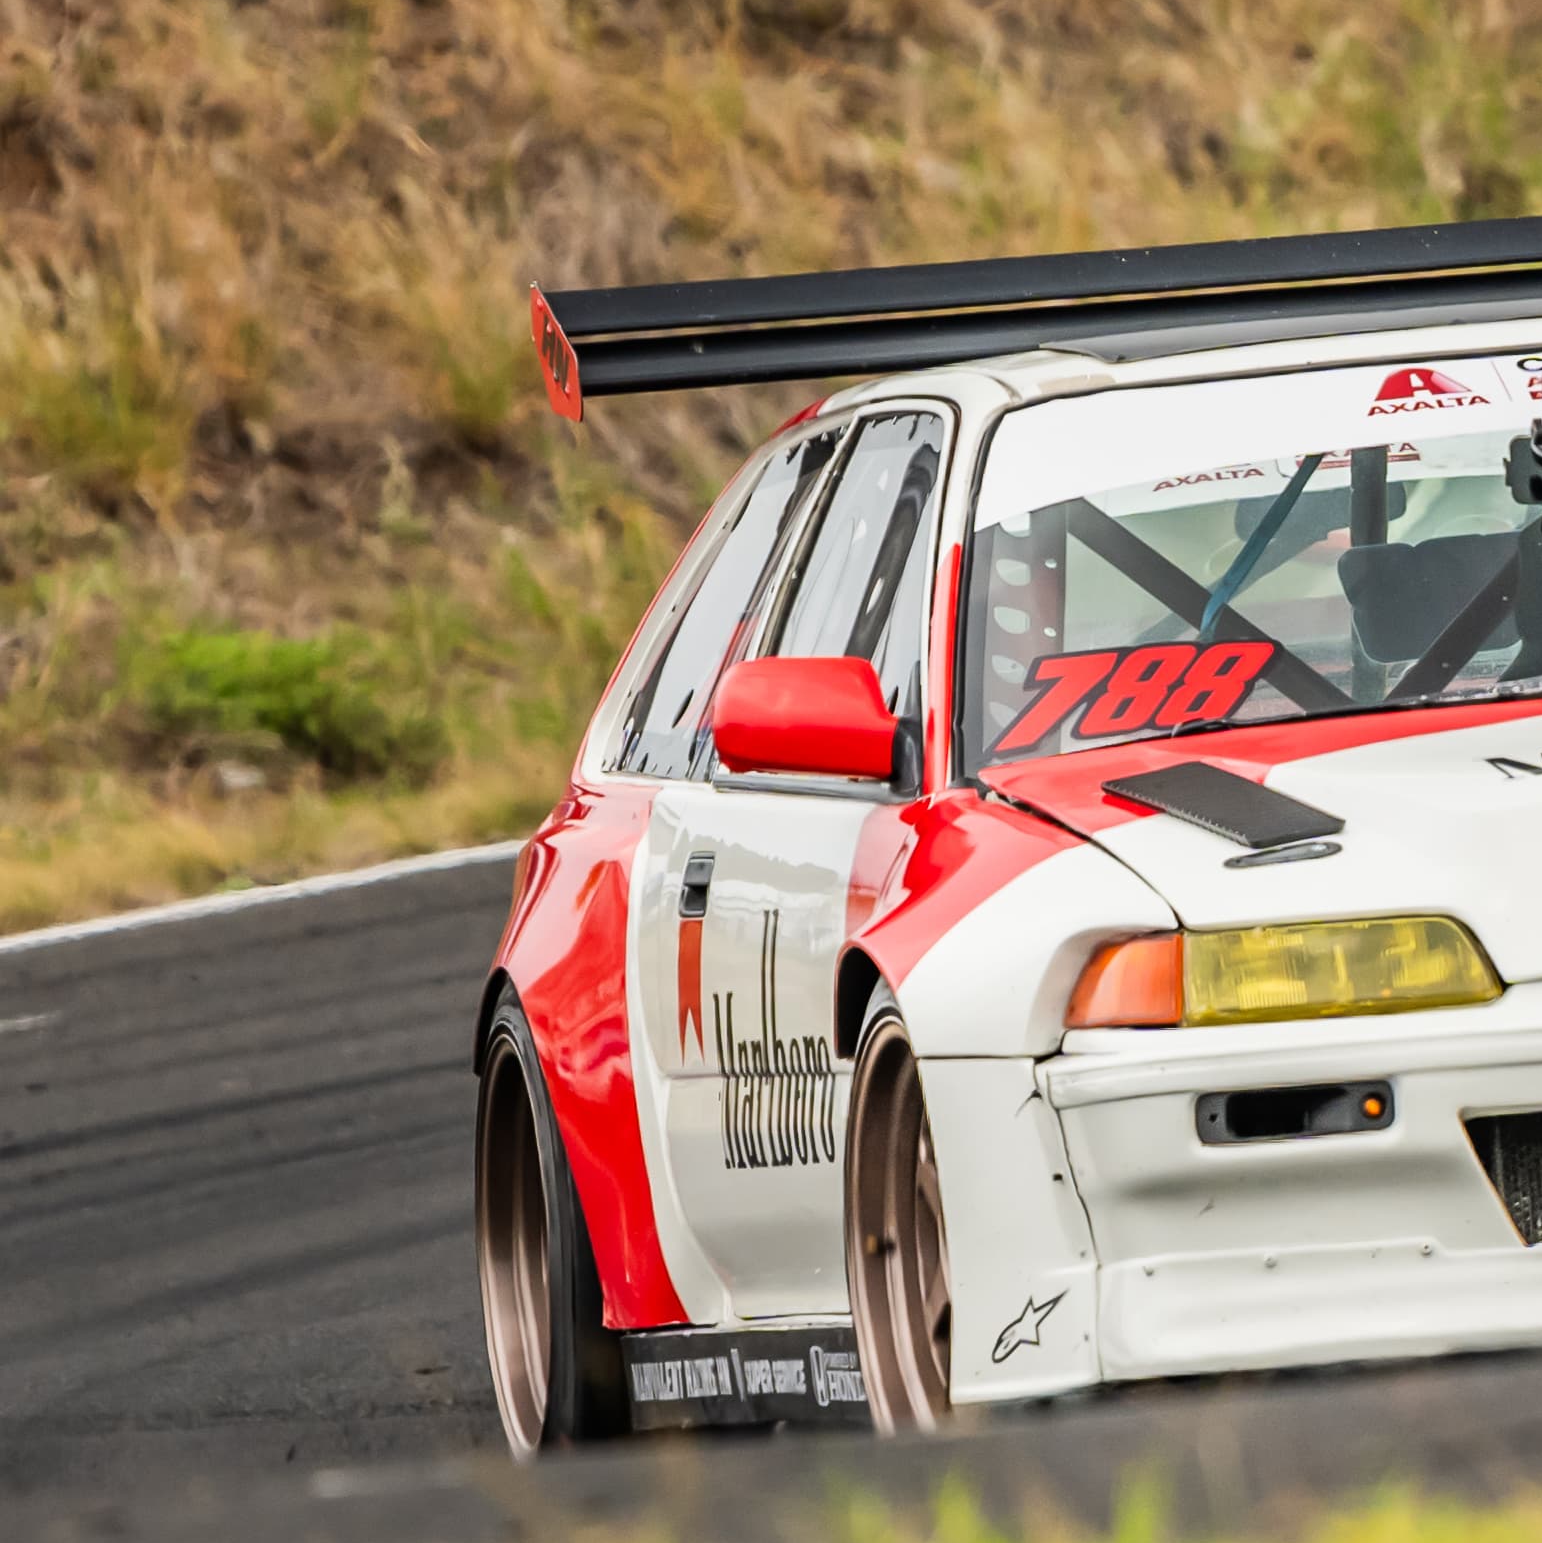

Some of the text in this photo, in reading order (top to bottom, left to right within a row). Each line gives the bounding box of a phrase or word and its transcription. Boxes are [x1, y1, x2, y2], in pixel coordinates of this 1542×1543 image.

[1367, 393, 1491, 416] AXALTA
[1152, 466, 1265, 492] AXALTA
[991, 640, 1277, 753] 788
[713, 908, 836, 1169] Marlboro
